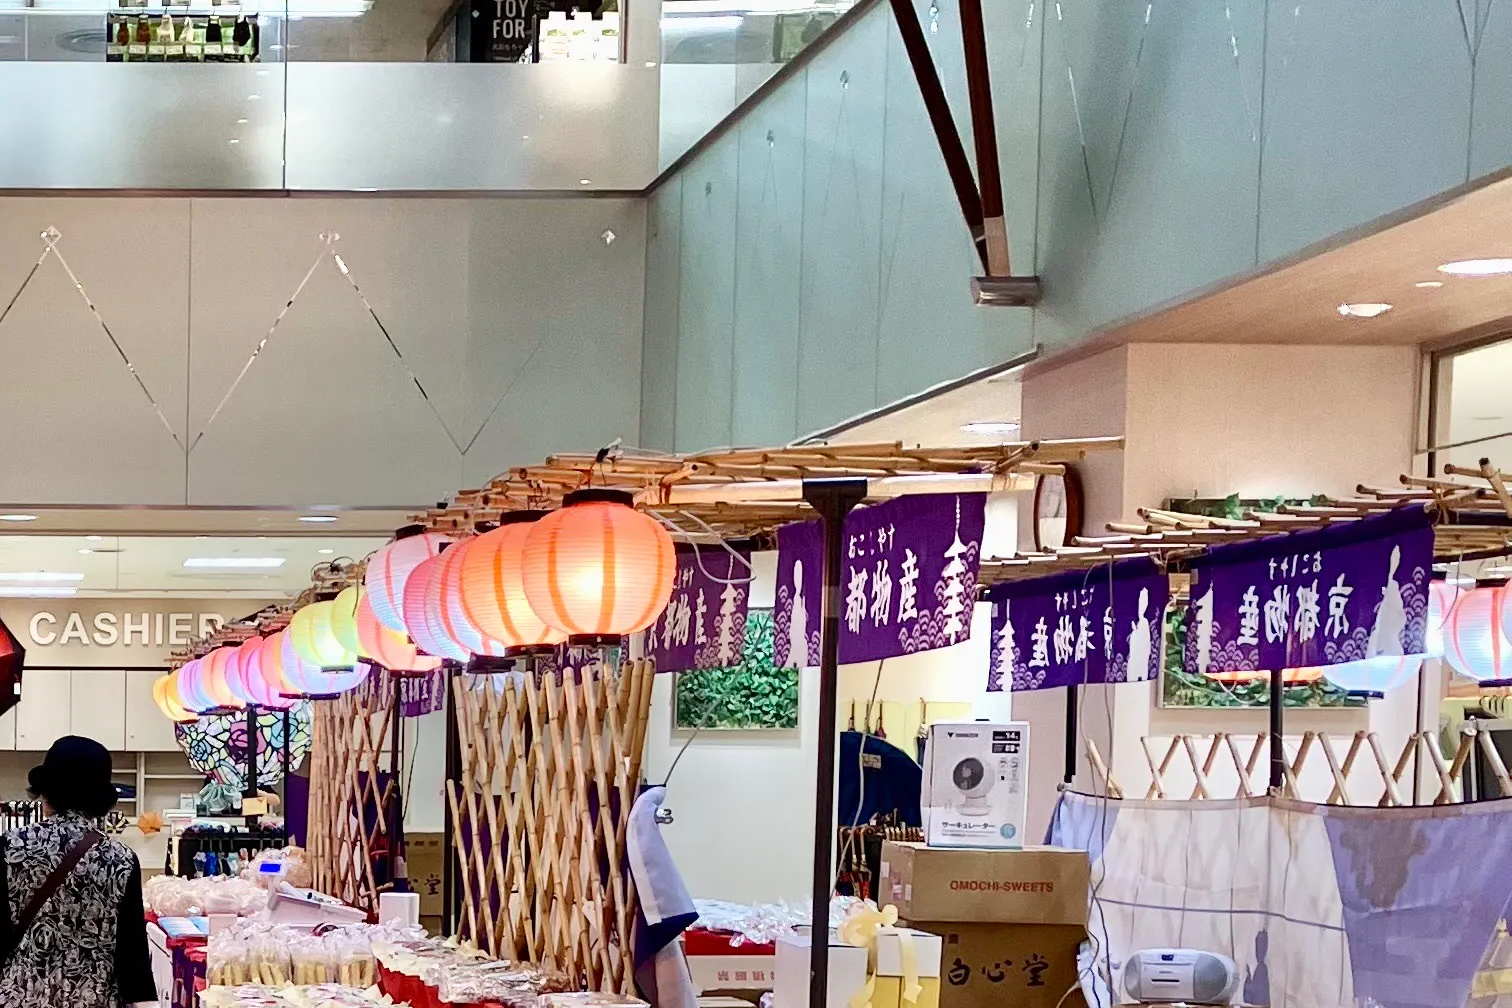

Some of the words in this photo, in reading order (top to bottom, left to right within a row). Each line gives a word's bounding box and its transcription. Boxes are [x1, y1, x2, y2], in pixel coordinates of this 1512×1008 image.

[494, 0, 527, 18] TOY
[493, 19, 526, 39] FOR
[29, 611, 225, 646] CASHIER
[949, 880, 1054, 893] OMOCHI-SWEETS
[947, 953, 1049, 986] 白心堂
